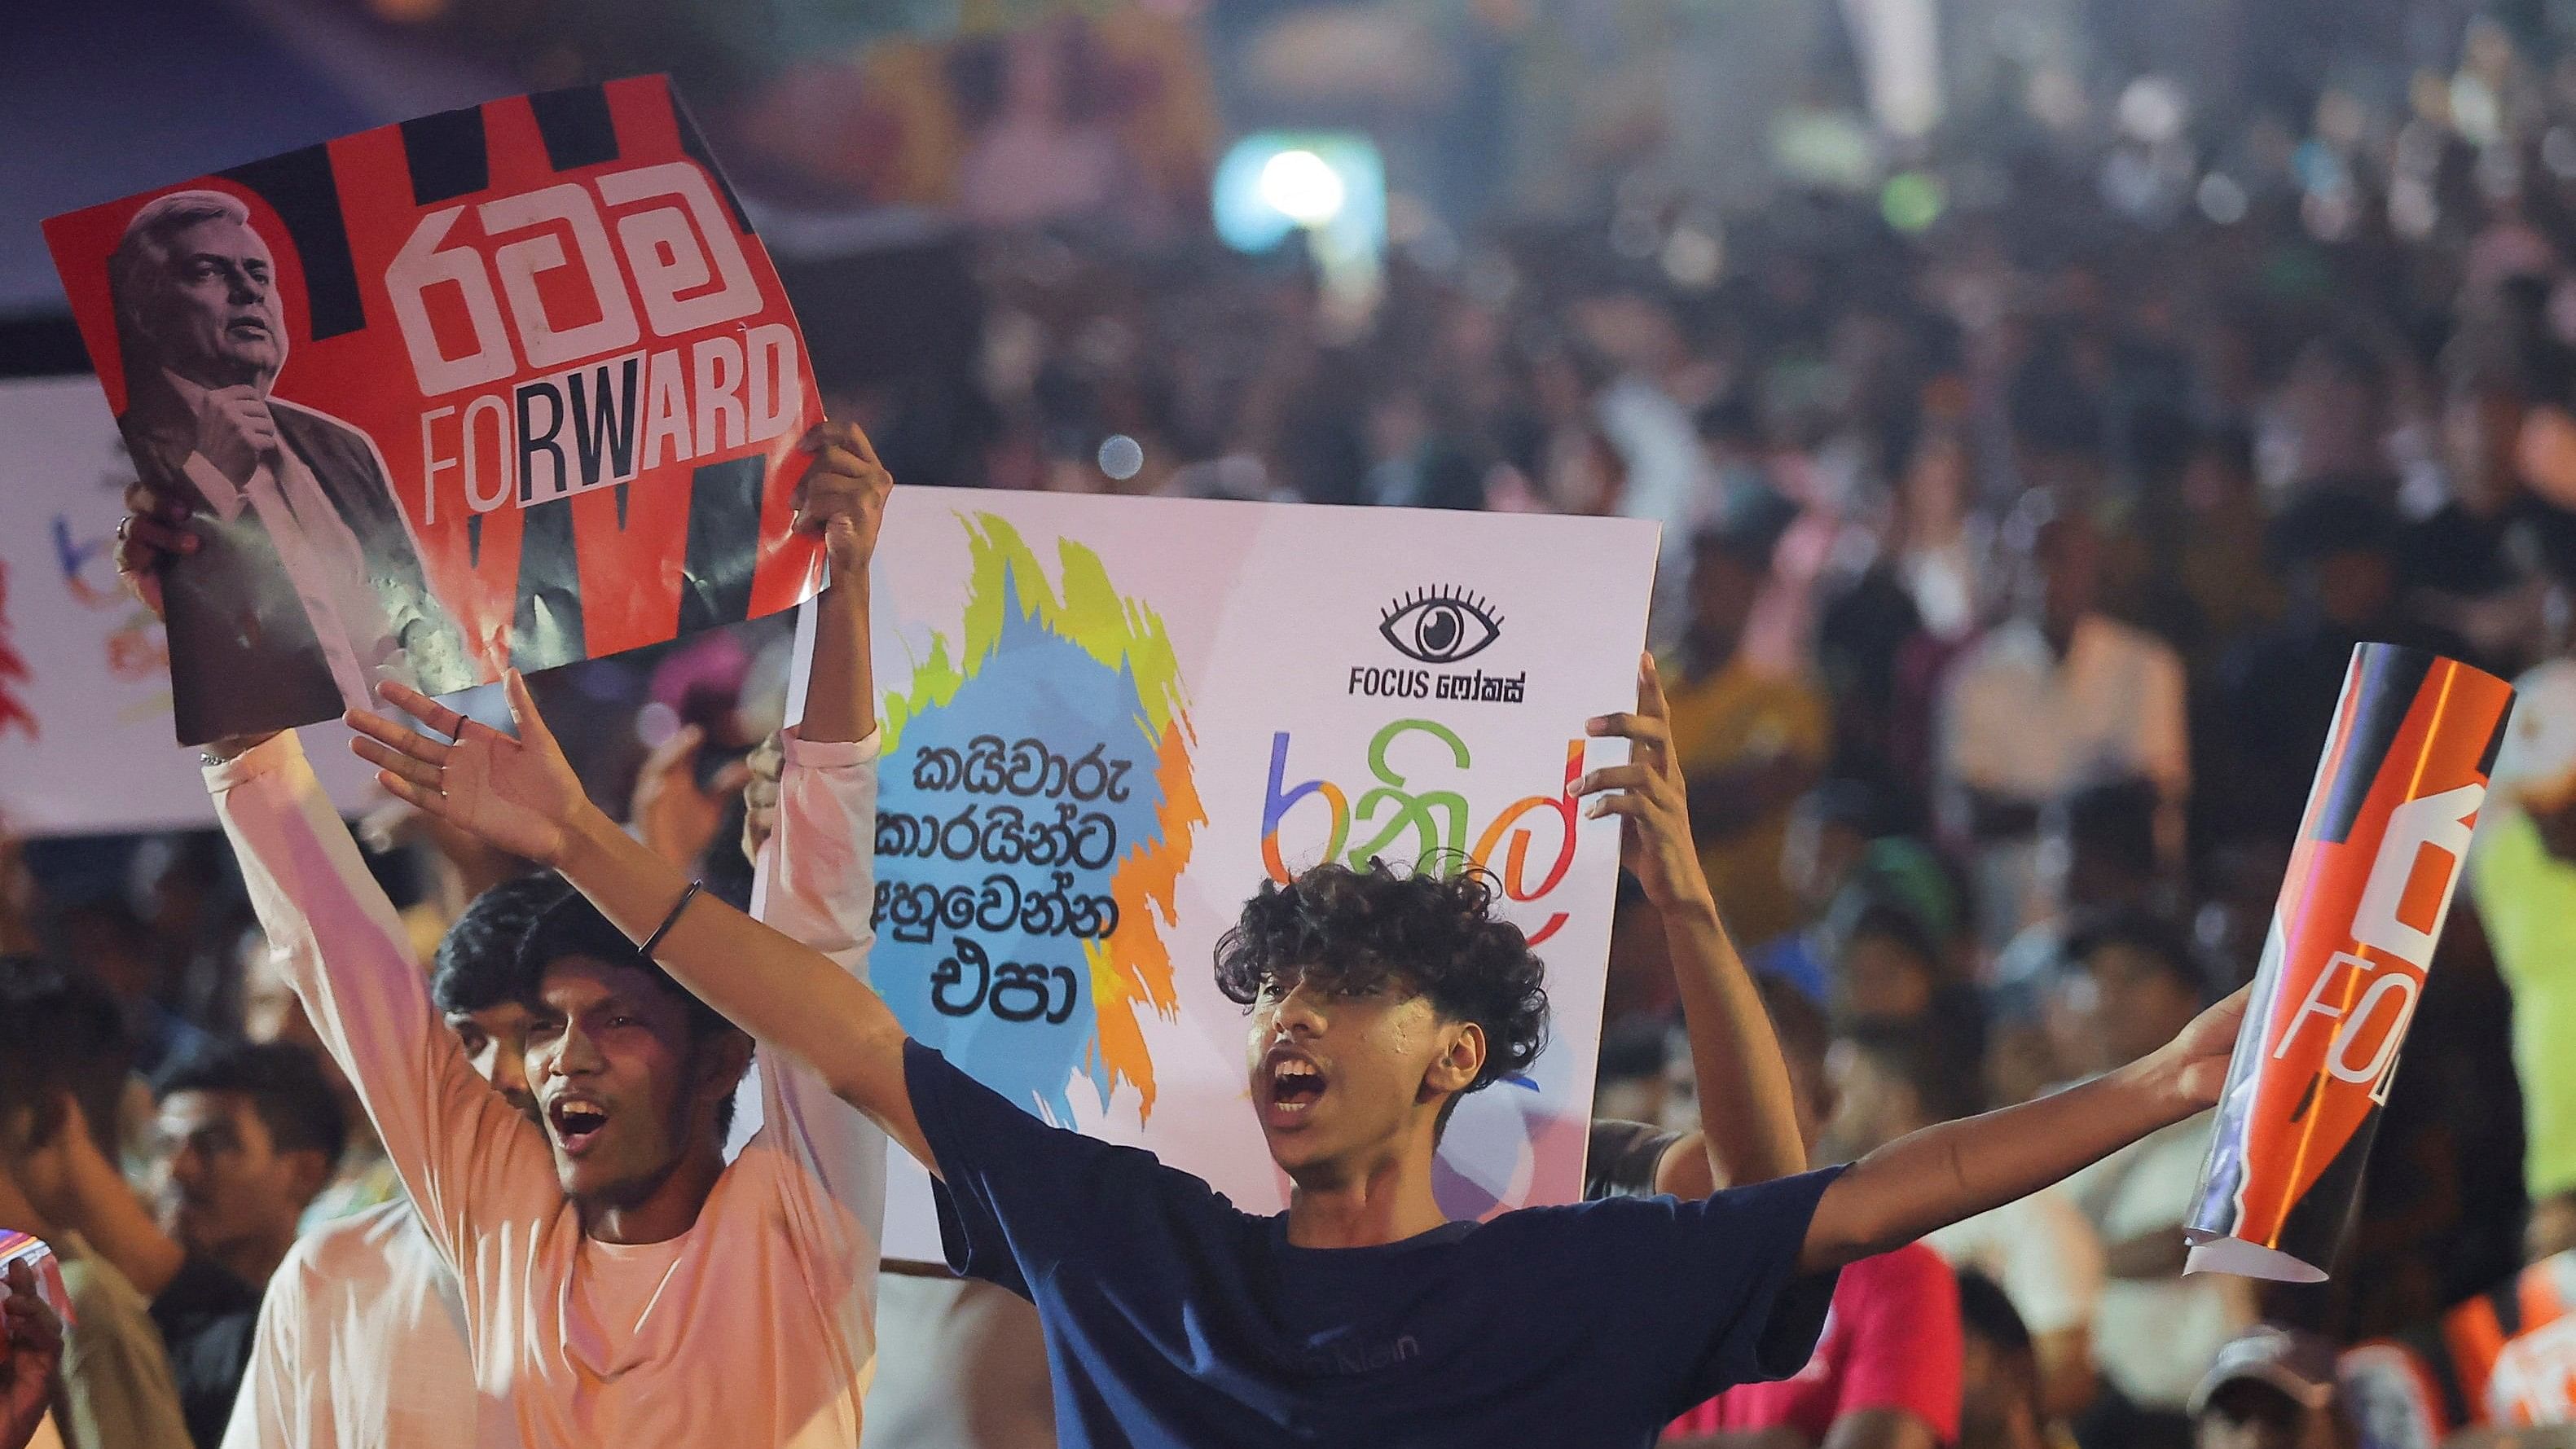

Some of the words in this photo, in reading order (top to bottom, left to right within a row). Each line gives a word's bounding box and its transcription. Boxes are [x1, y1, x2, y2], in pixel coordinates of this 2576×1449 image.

[385, 161, 764, 397] රටම
[420, 323, 800, 525] FORWARD
[1348, 666, 1430, 700] FOCUS
[912, 735, 1132, 801] කයිවාරු
[874, 803, 1117, 870] කාරයින්ට
[930, 937, 1077, 1025] එපා
[2273, 950, 2417, 1106] FO
